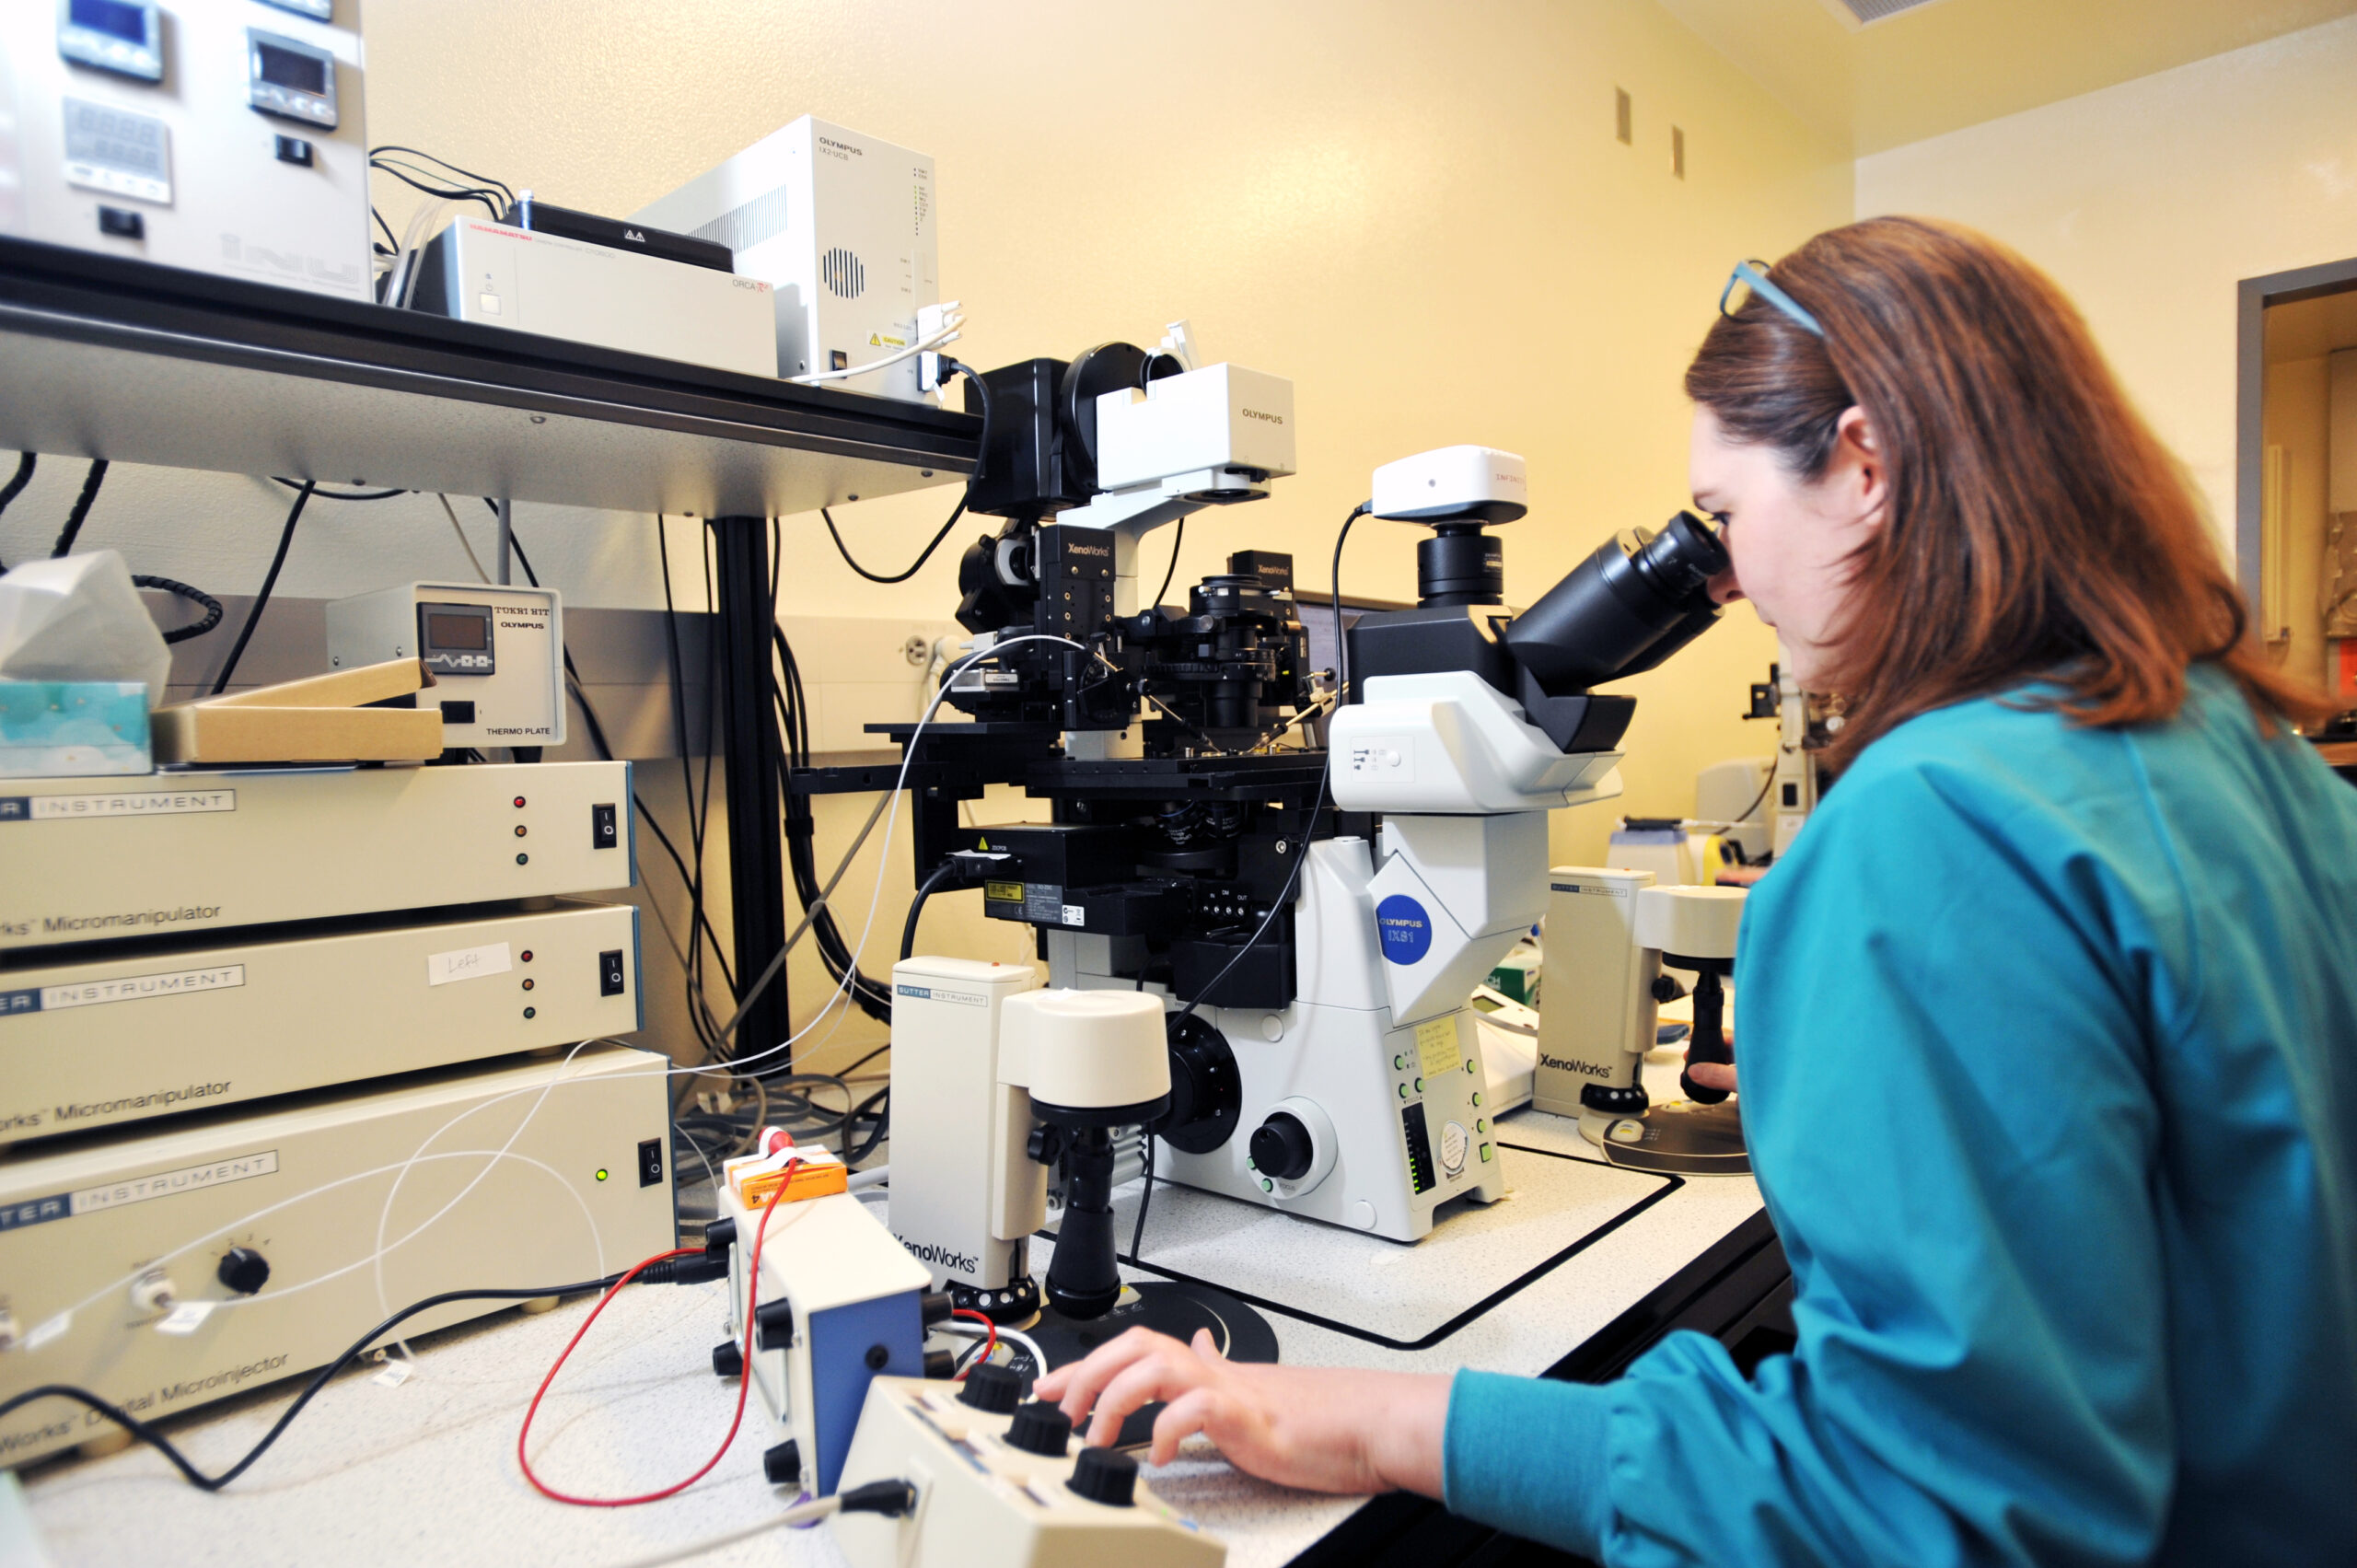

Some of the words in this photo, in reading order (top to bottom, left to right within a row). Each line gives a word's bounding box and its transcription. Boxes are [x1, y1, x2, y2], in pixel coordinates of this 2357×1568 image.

[819, 136, 863, 156] OLYMPUS
[1242, 408, 1283, 424] OLYMPUS
[1068, 542, 1109, 557] XenoWorks
[486, 727, 523, 736] THERMO
[40, 796, 223, 813] INSTRUMENT
[43, 905, 221, 933] Micromanipulator
[1379, 918, 1422, 928] OLYMPUS
[1388, 930, 1414, 943] IX81
[447, 953, 481, 973] Left
[50, 971, 232, 1003] INSTRUMENT
[898, 986, 929, 997] SUTTER
[933, 992, 984, 1005] INSTRUMENT
[1540, 1053, 1612, 1078] XenoWorks
[54, 1081, 232, 1122] Micromanipulator
[79, 1158, 265, 1207] INSTRUMENT
[162, 1353, 289, 1401] Microinjector
